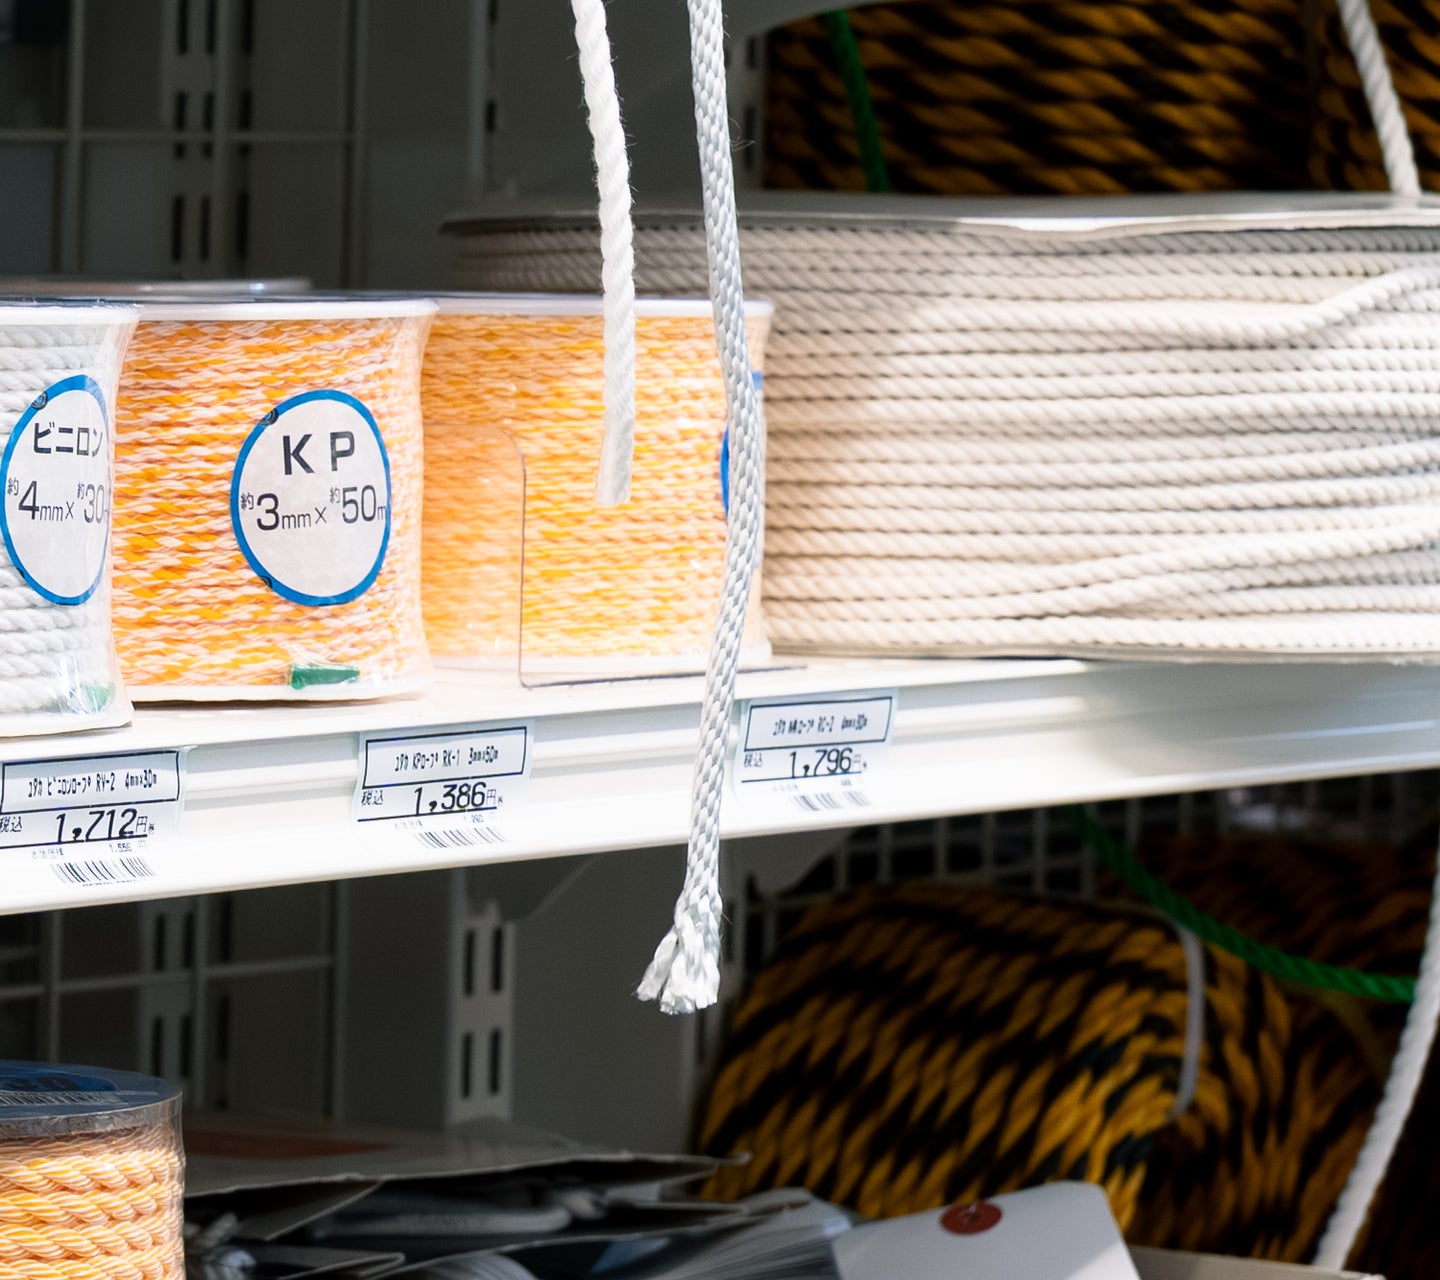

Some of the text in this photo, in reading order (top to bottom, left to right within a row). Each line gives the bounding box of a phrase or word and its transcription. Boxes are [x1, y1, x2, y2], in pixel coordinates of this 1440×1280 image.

[32, 420, 105, 457] ビニロン
[360, 780, 497, 816] 税込 1,386円
